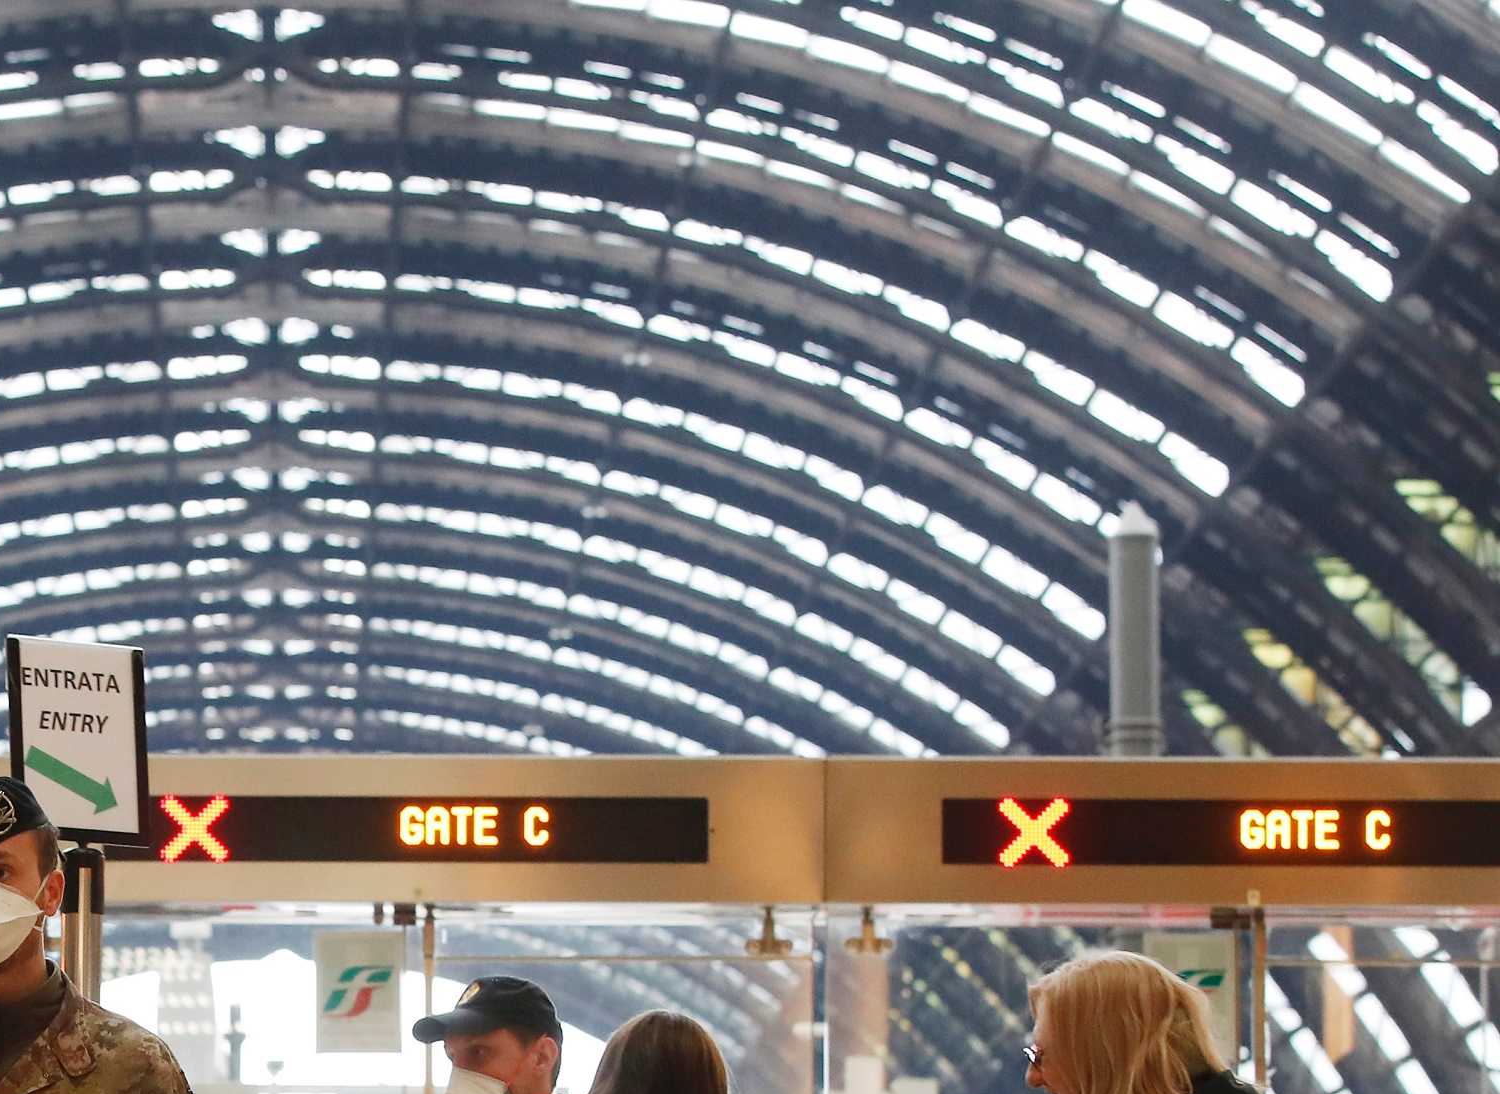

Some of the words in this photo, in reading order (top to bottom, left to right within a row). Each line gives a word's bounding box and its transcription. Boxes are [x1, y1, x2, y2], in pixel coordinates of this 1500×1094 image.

[21, 666, 120, 694] ENTRATA
[38, 710, 109, 735] ENTRY
[397, 804, 500, 848] GATE
[523, 804, 551, 848] C
[1239, 808, 1341, 852] GATE
[1364, 808, 1392, 851] C
